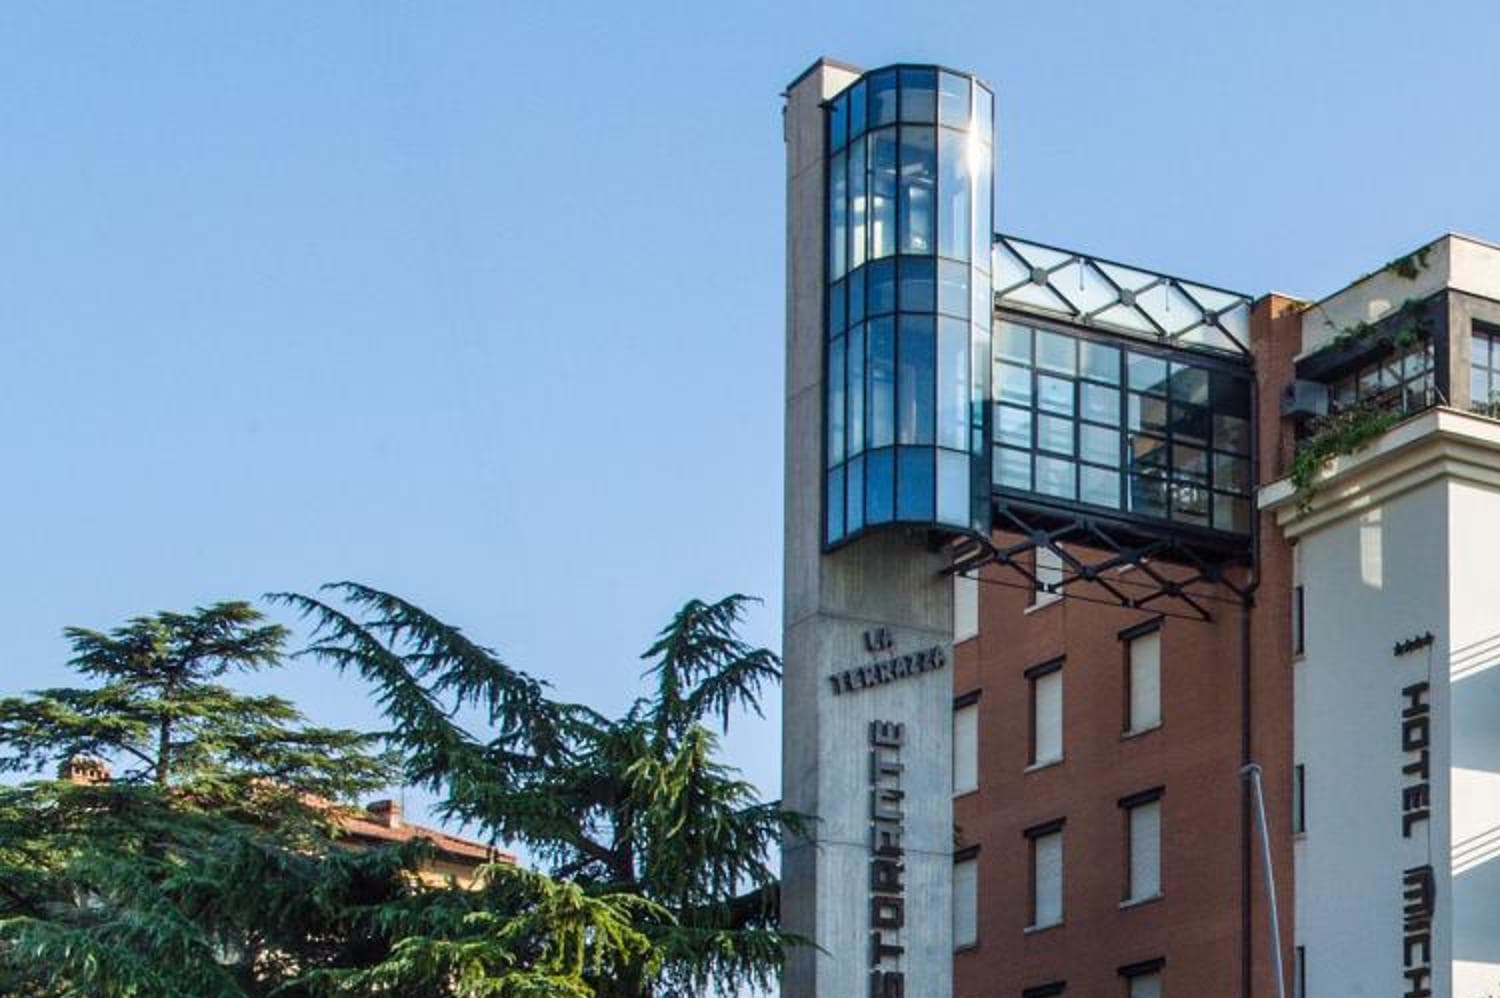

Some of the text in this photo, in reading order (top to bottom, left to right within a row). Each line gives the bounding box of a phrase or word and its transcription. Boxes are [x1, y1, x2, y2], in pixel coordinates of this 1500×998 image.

[864, 627, 894, 653] LA
[830, 645, 945, 696] TERRAZZA
[1401, 681, 1431, 838] HOTEL
